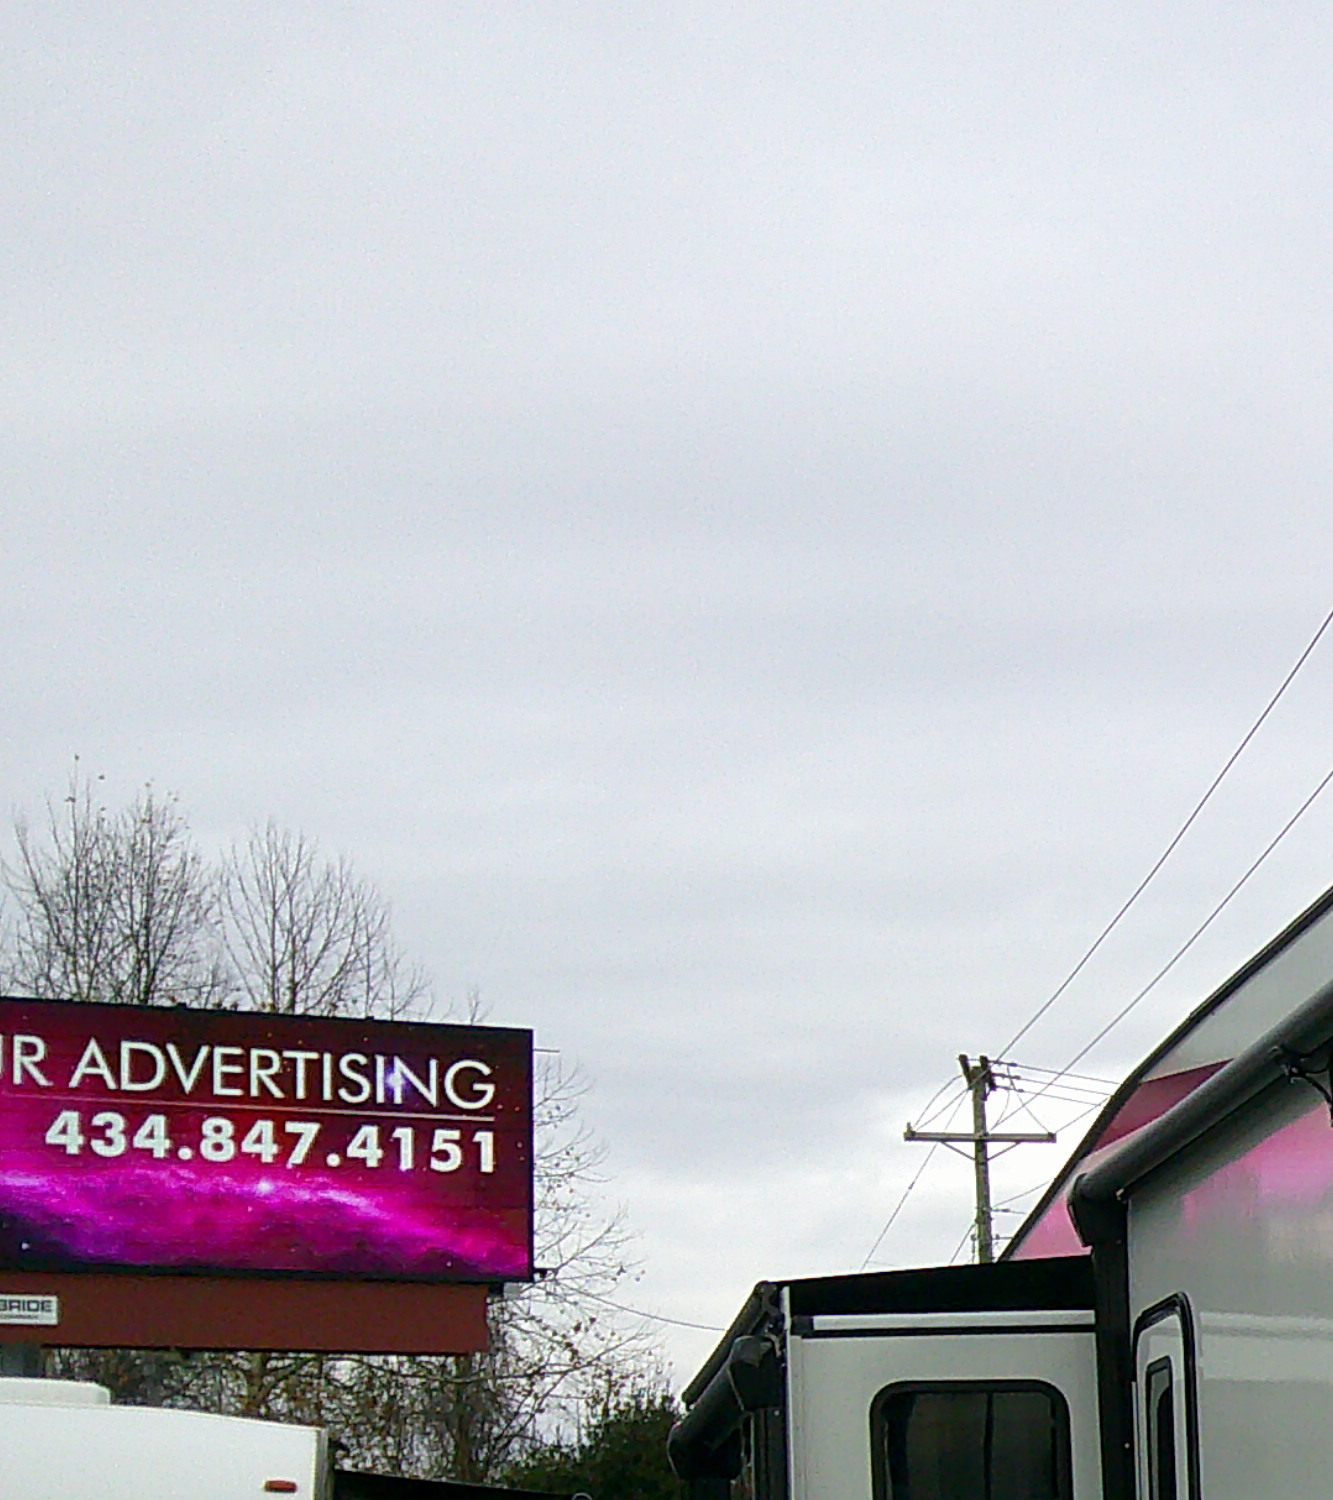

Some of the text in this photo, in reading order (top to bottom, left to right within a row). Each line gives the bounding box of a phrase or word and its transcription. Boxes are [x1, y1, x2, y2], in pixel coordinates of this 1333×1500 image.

[0, 1033, 496, 1111] R ADVERTISING
[45, 1109, 495, 1174] 434.847.4151
